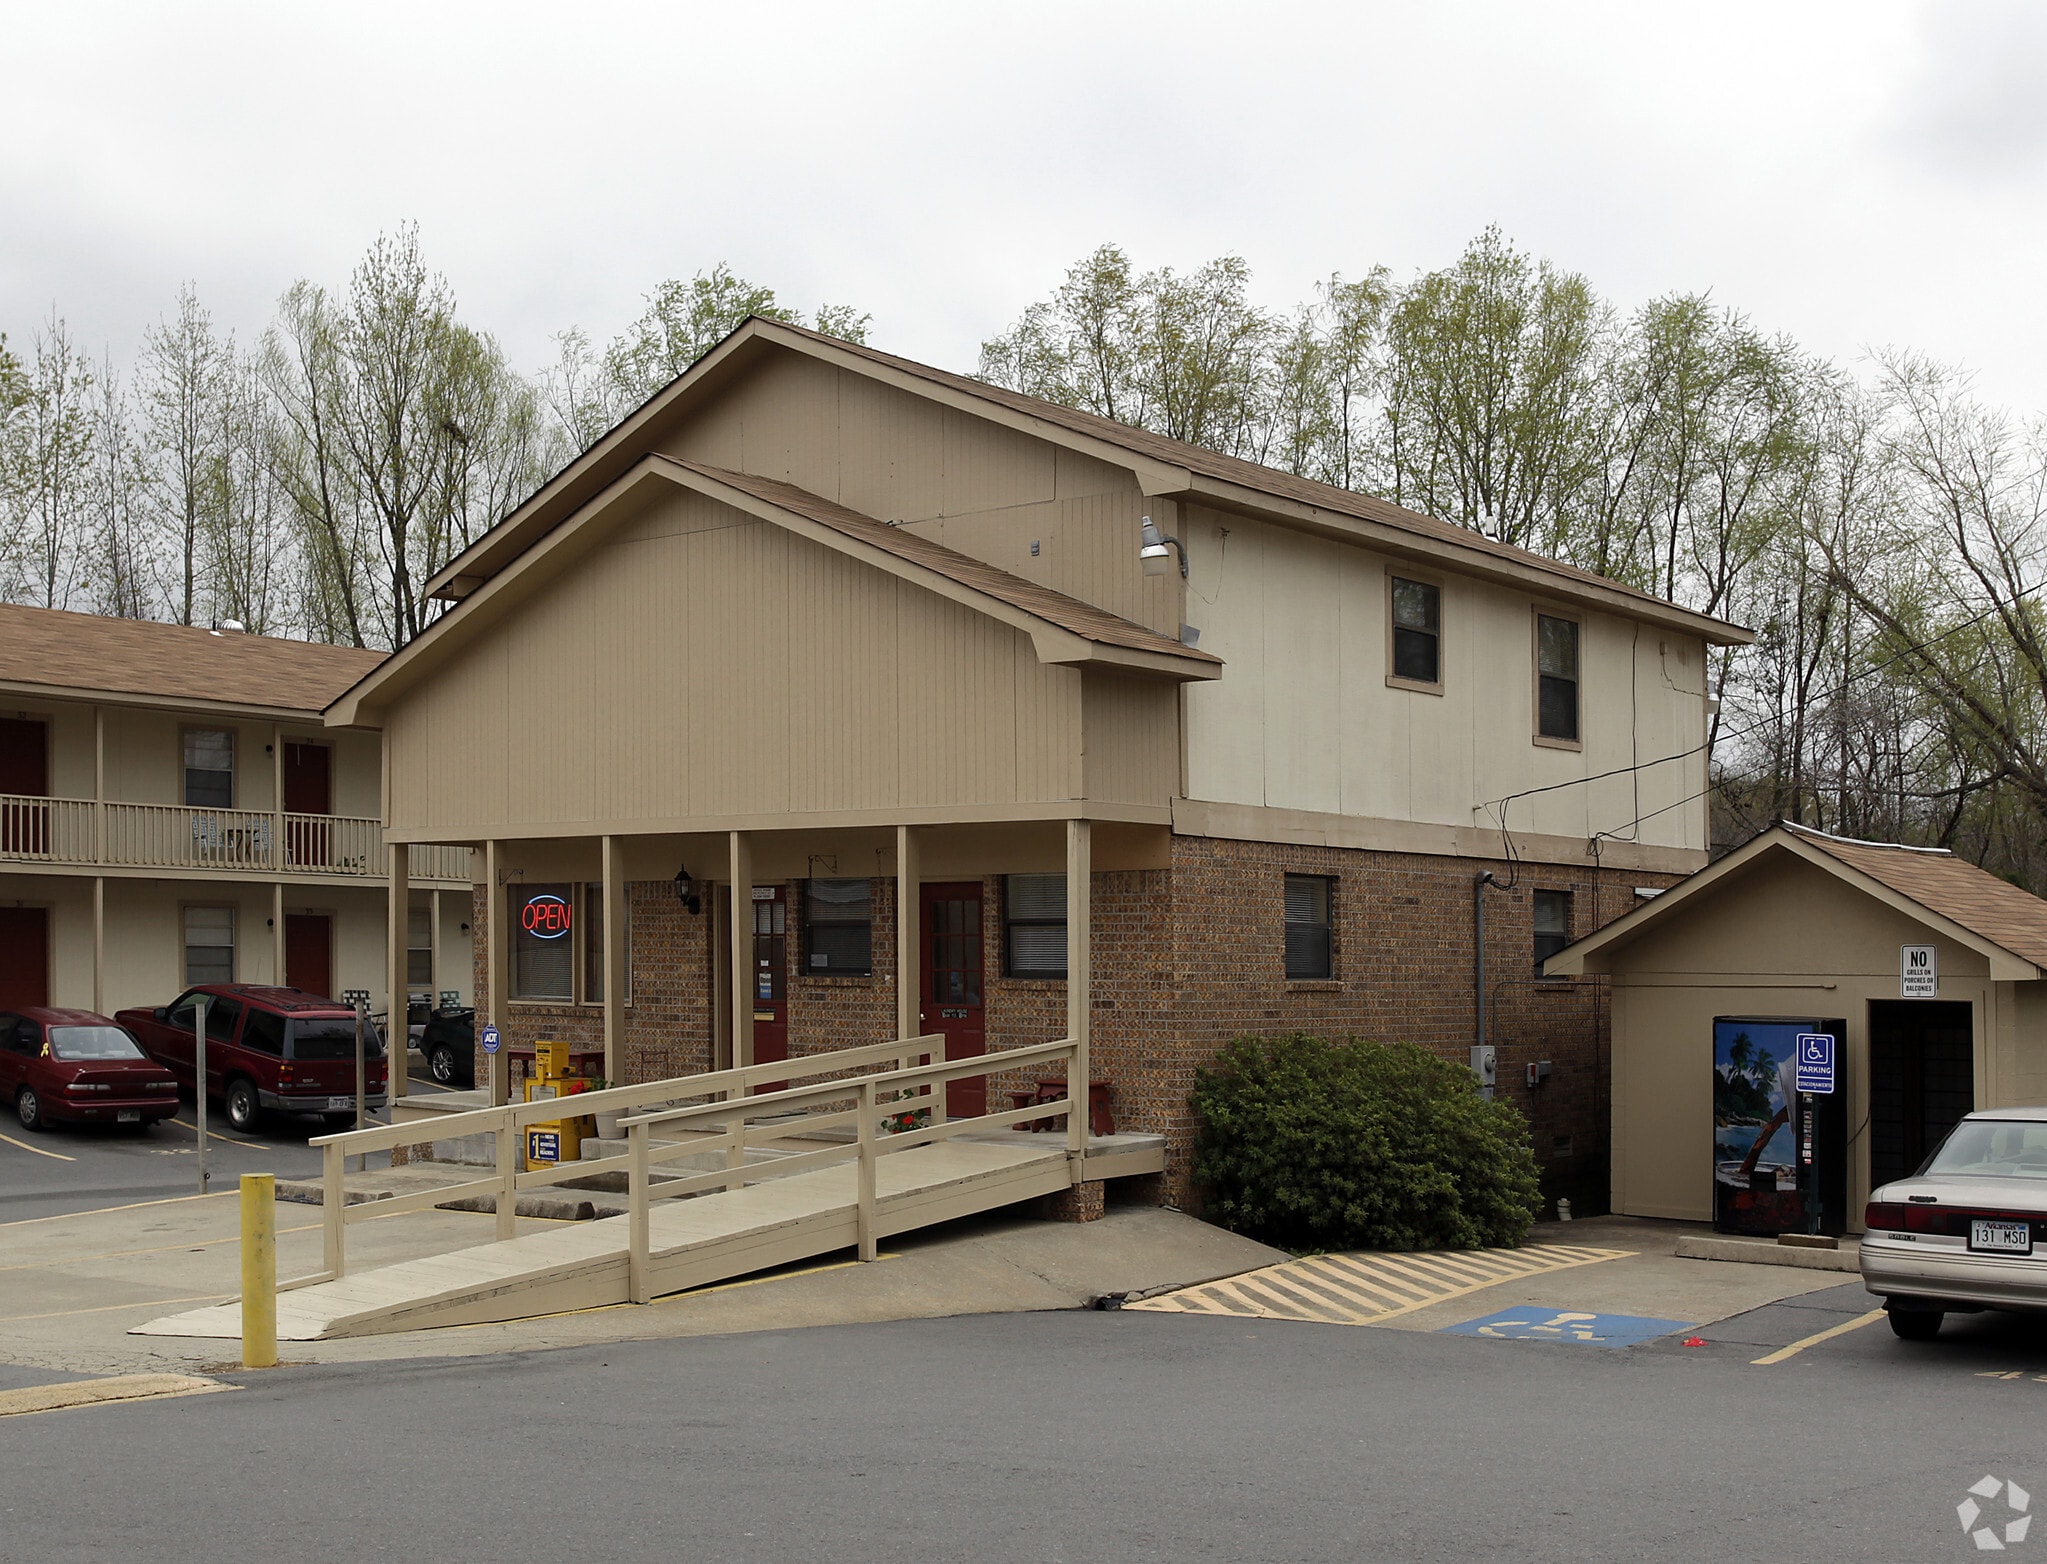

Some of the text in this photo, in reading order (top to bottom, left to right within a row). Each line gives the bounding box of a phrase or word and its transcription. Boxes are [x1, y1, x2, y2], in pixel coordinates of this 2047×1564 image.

[522, 903, 572, 930] OPEN
[1910, 951, 1927, 967] NO
[484, 1033, 498, 1043] ADT
[1798, 1065, 1832, 1074] PARKING
[1984, 1222, 2016, 1230] Arkansas
[1976, 1229, 1994, 1243] 131
